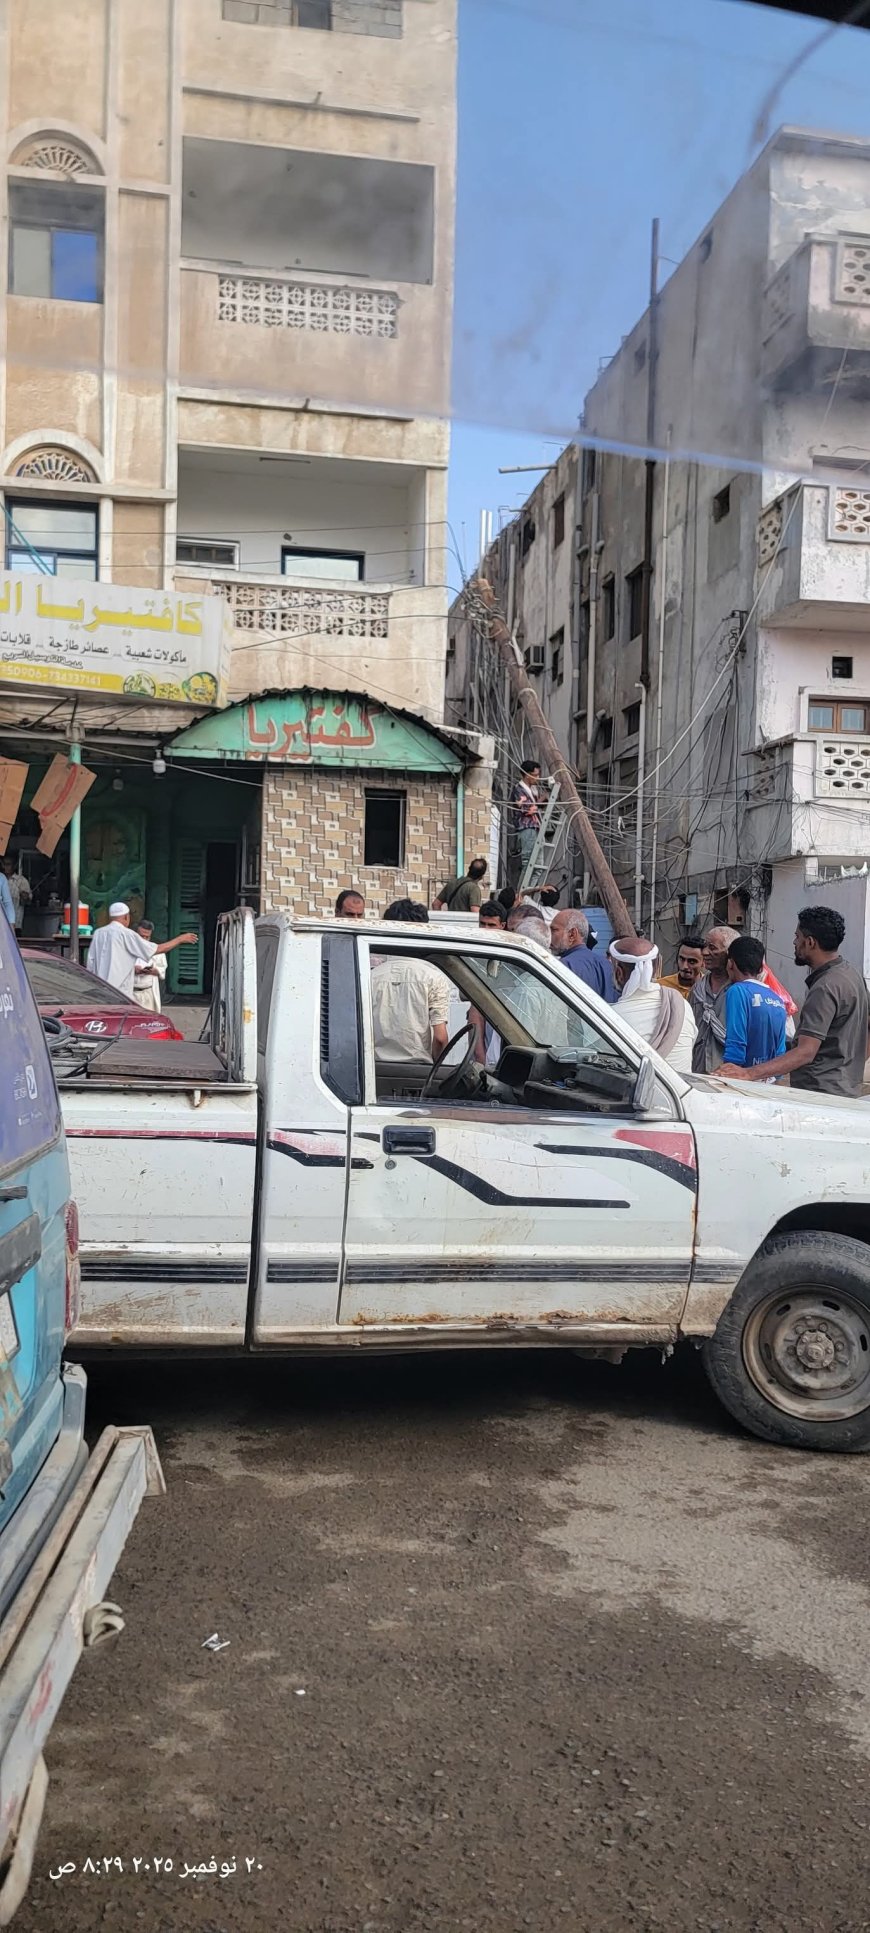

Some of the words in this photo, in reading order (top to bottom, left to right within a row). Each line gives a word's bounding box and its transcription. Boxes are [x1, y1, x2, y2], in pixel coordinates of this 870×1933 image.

[36, 584, 204, 636] كافتيريا
[49, 634, 80, 653] طازجة
[82, 640, 110, 656] عصائر
[126, 644, 151, 659] شعبية
[246, 703, 388, 761] كفتيريا
